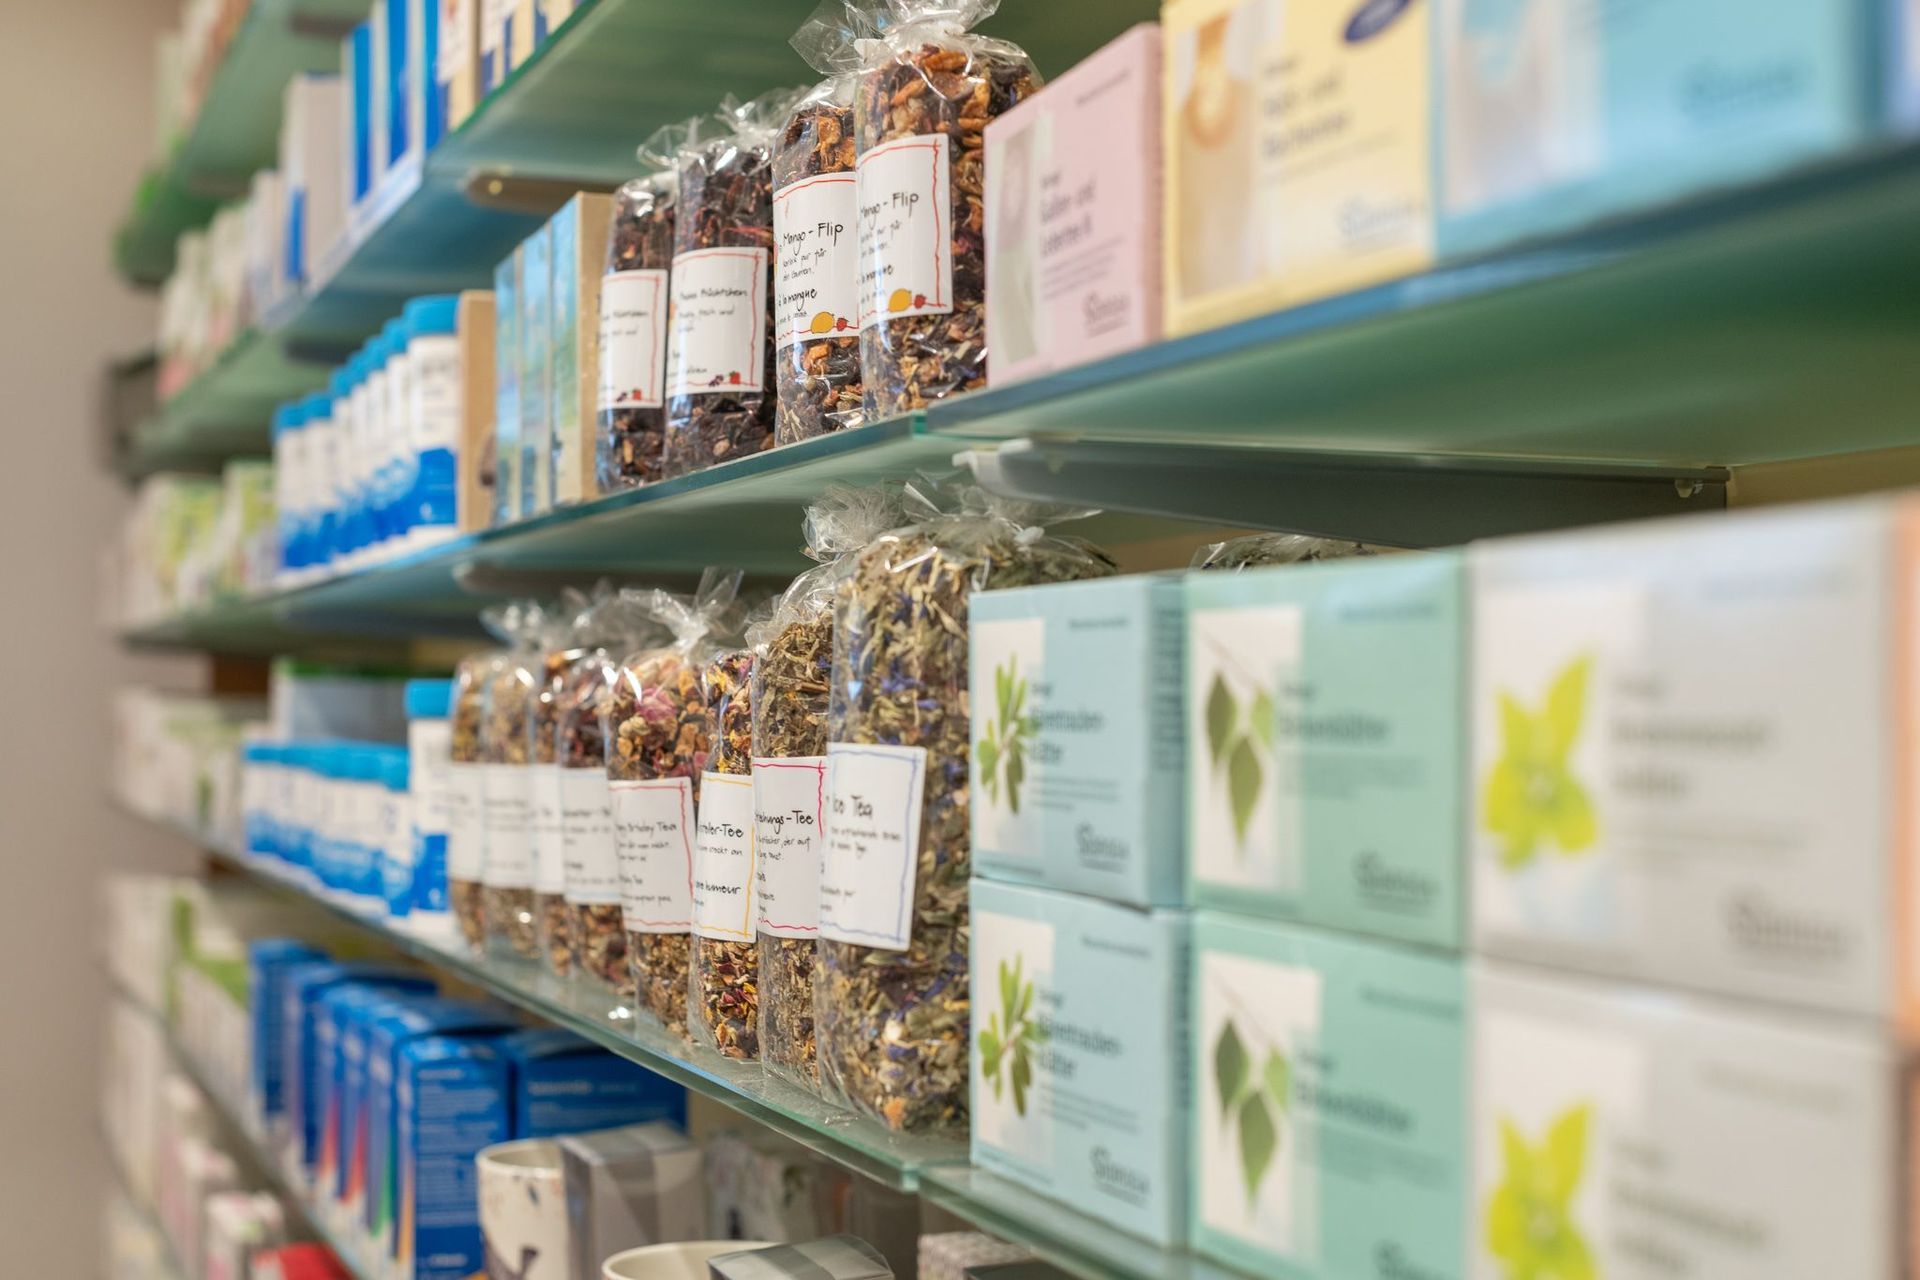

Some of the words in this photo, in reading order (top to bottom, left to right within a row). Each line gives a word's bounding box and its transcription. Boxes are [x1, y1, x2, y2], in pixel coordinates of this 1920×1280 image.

[892, 192, 919, 219] Flip
[783, 231, 806, 256] Mango
[818, 221, 844, 247] Flip
[851, 794, 873, 820] Tea
[656, 821, 677, 832] Tea
